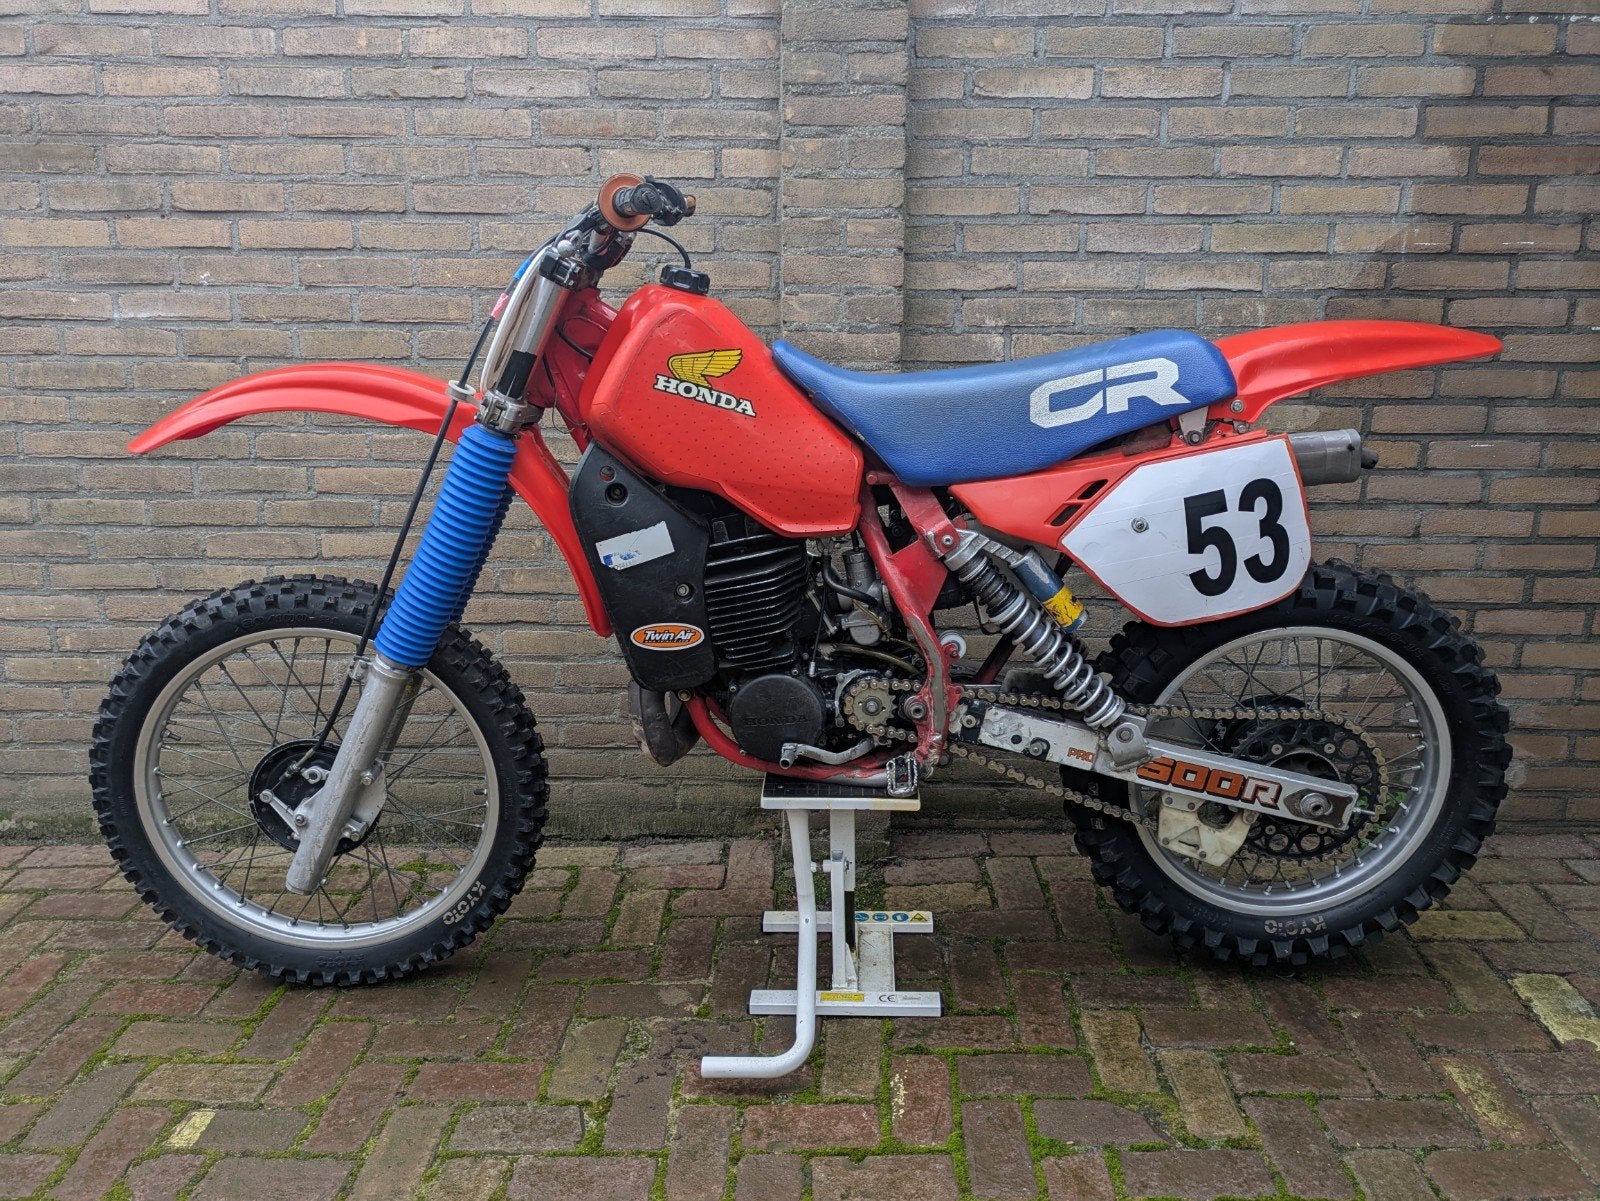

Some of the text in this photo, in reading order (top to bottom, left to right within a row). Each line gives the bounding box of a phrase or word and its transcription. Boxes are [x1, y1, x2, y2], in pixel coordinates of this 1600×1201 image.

[653, 374, 757, 418] HONDA
[1029, 357, 1191, 429] CR
[1183, 478, 1290, 597] 53
[644, 629, 695, 641] Twin Air
[1067, 747, 1096, 763] PRO
[442, 880, 487, 925] KYOTO
[1264, 914, 1328, 938] KYOTO
[878, 994, 896, 1003] CE
